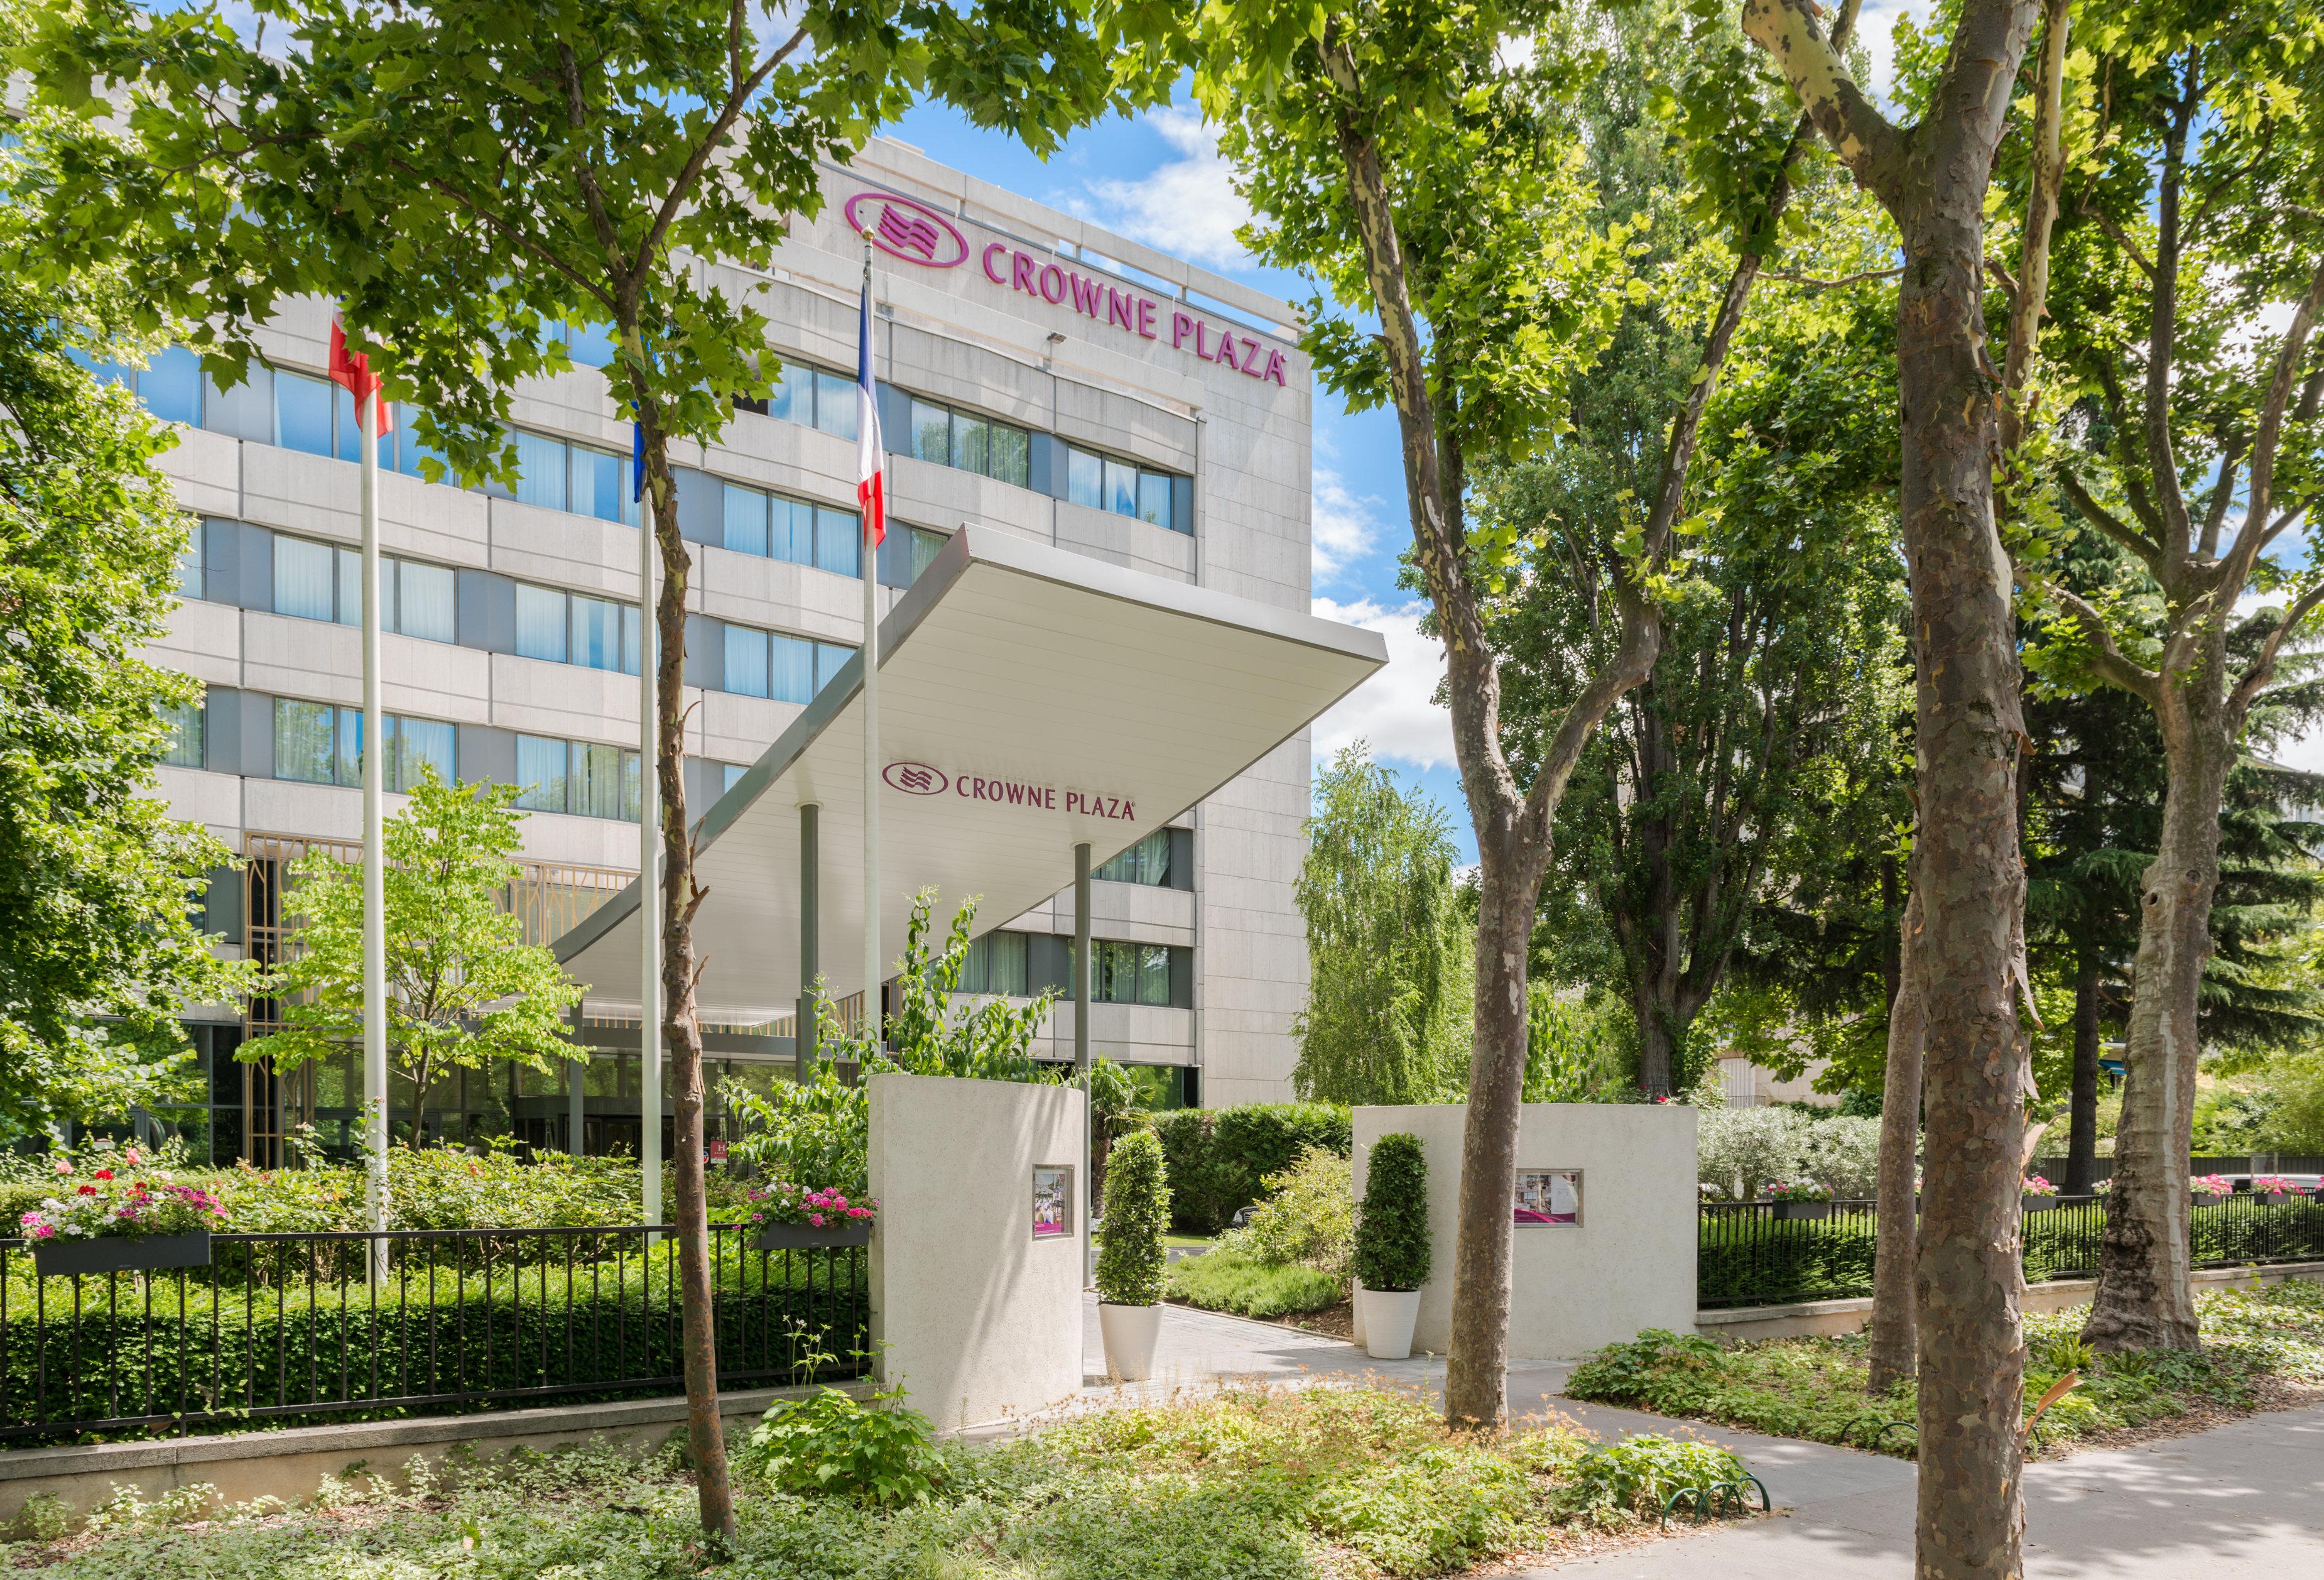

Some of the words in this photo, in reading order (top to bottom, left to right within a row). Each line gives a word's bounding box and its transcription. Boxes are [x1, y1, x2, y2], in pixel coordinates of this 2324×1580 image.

[982, 242, 1157, 340] CROWNE
[1173, 311, 1286, 386] PLAZA
[956, 775, 1056, 810] CROWNE
[1067, 792, 1135, 821] PLAZA
